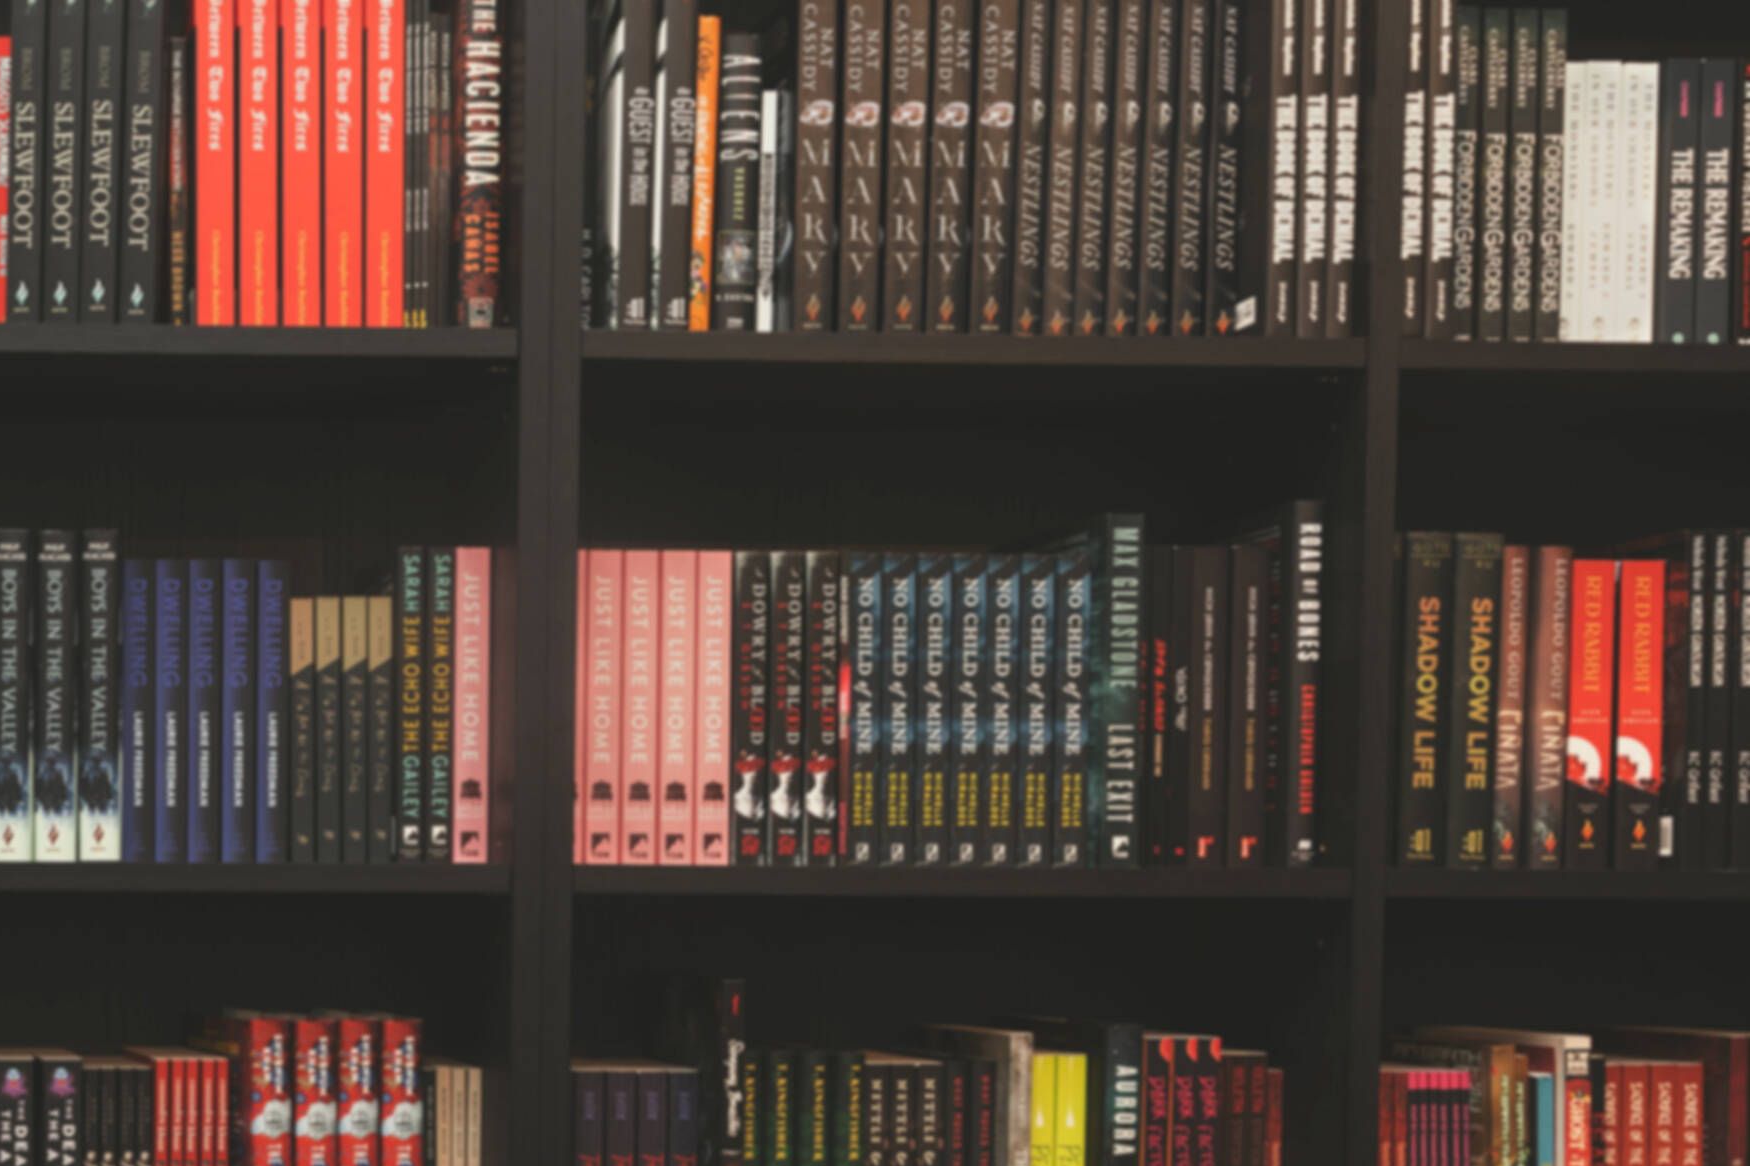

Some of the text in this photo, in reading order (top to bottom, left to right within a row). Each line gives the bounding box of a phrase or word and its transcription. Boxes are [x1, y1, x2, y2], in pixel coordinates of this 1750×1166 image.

[464, 0, 501, 187] THE HACIENDA
[802, 4, 818, 92] CASSIDY
[820, 27, 834, 69] NAT
[720, 53, 762, 161] ALIENS
[13, 101, 36, 249] SLEWFOOT
[1114, 143, 1136, 270] NESTLINGS
[1668, 148, 1694, 280] THE REMAKING
[403, 554, 421, 613] SARAH
[1299, 523, 1322, 574] ROAD
[403, 616, 421, 659] WIFE
[1110, 527, 1139, 690] MAX GLADSTONE
[1298, 600, 1322, 662] BONES
[1508, 557, 1523, 647] LEOPOLDO
[1584, 575, 1602, 693] RED RABBIT
[1, 568, 18, 752] BOYS IN THE VALLEY
[403, 663, 421, 715] ECHO
[460, 573, 481, 762] JUST LIKE HOME
[891, 578, 908, 755] NO CHILD MINE
[1412, 596, 1440, 790] SHADOW LIFE
[403, 755, 421, 819] GAILEY
[1105, 723, 1135, 823] LAST EXIT
[1112, 1064, 1139, 1156] AURORA
[1568, 1100, 1589, 1150] GHOST
